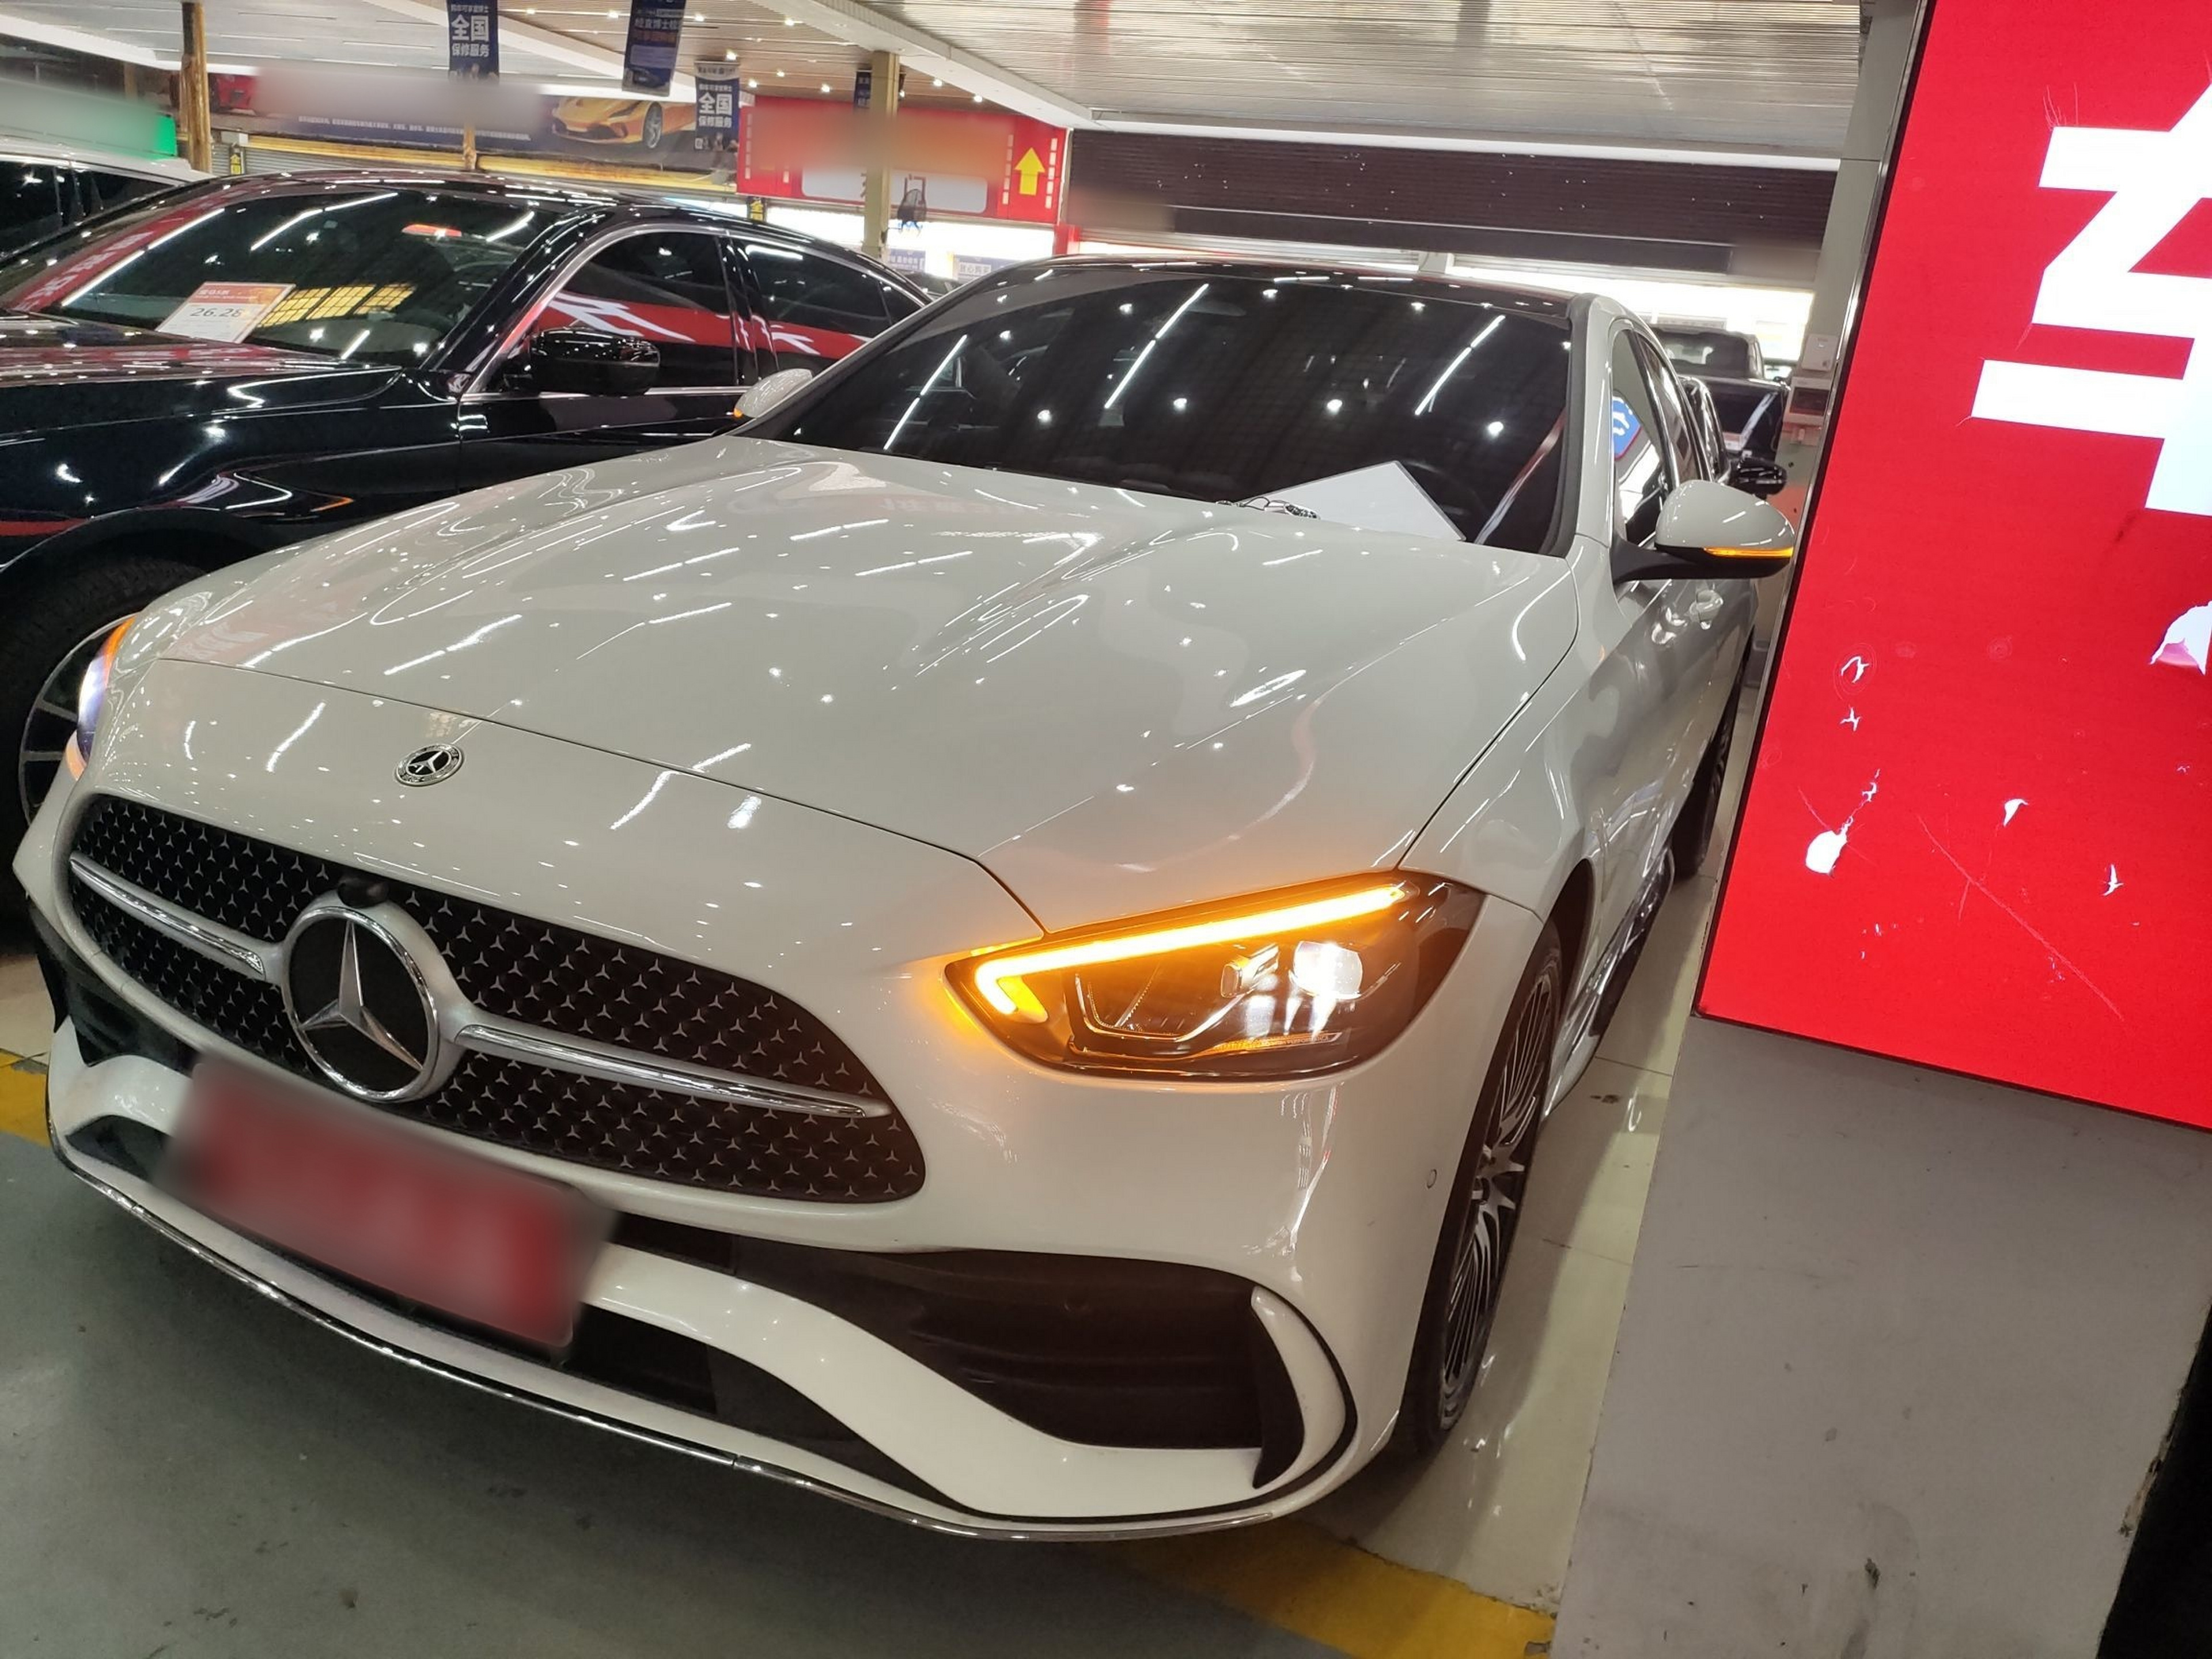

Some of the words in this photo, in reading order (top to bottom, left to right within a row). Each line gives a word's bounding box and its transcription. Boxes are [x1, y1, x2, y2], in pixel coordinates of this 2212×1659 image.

[451, 14, 489, 41] 全国
[452, 43, 490, 57] 保修服务
[699, 92, 732, 116] 全国
[699, 116, 732, 127] 保修服务
